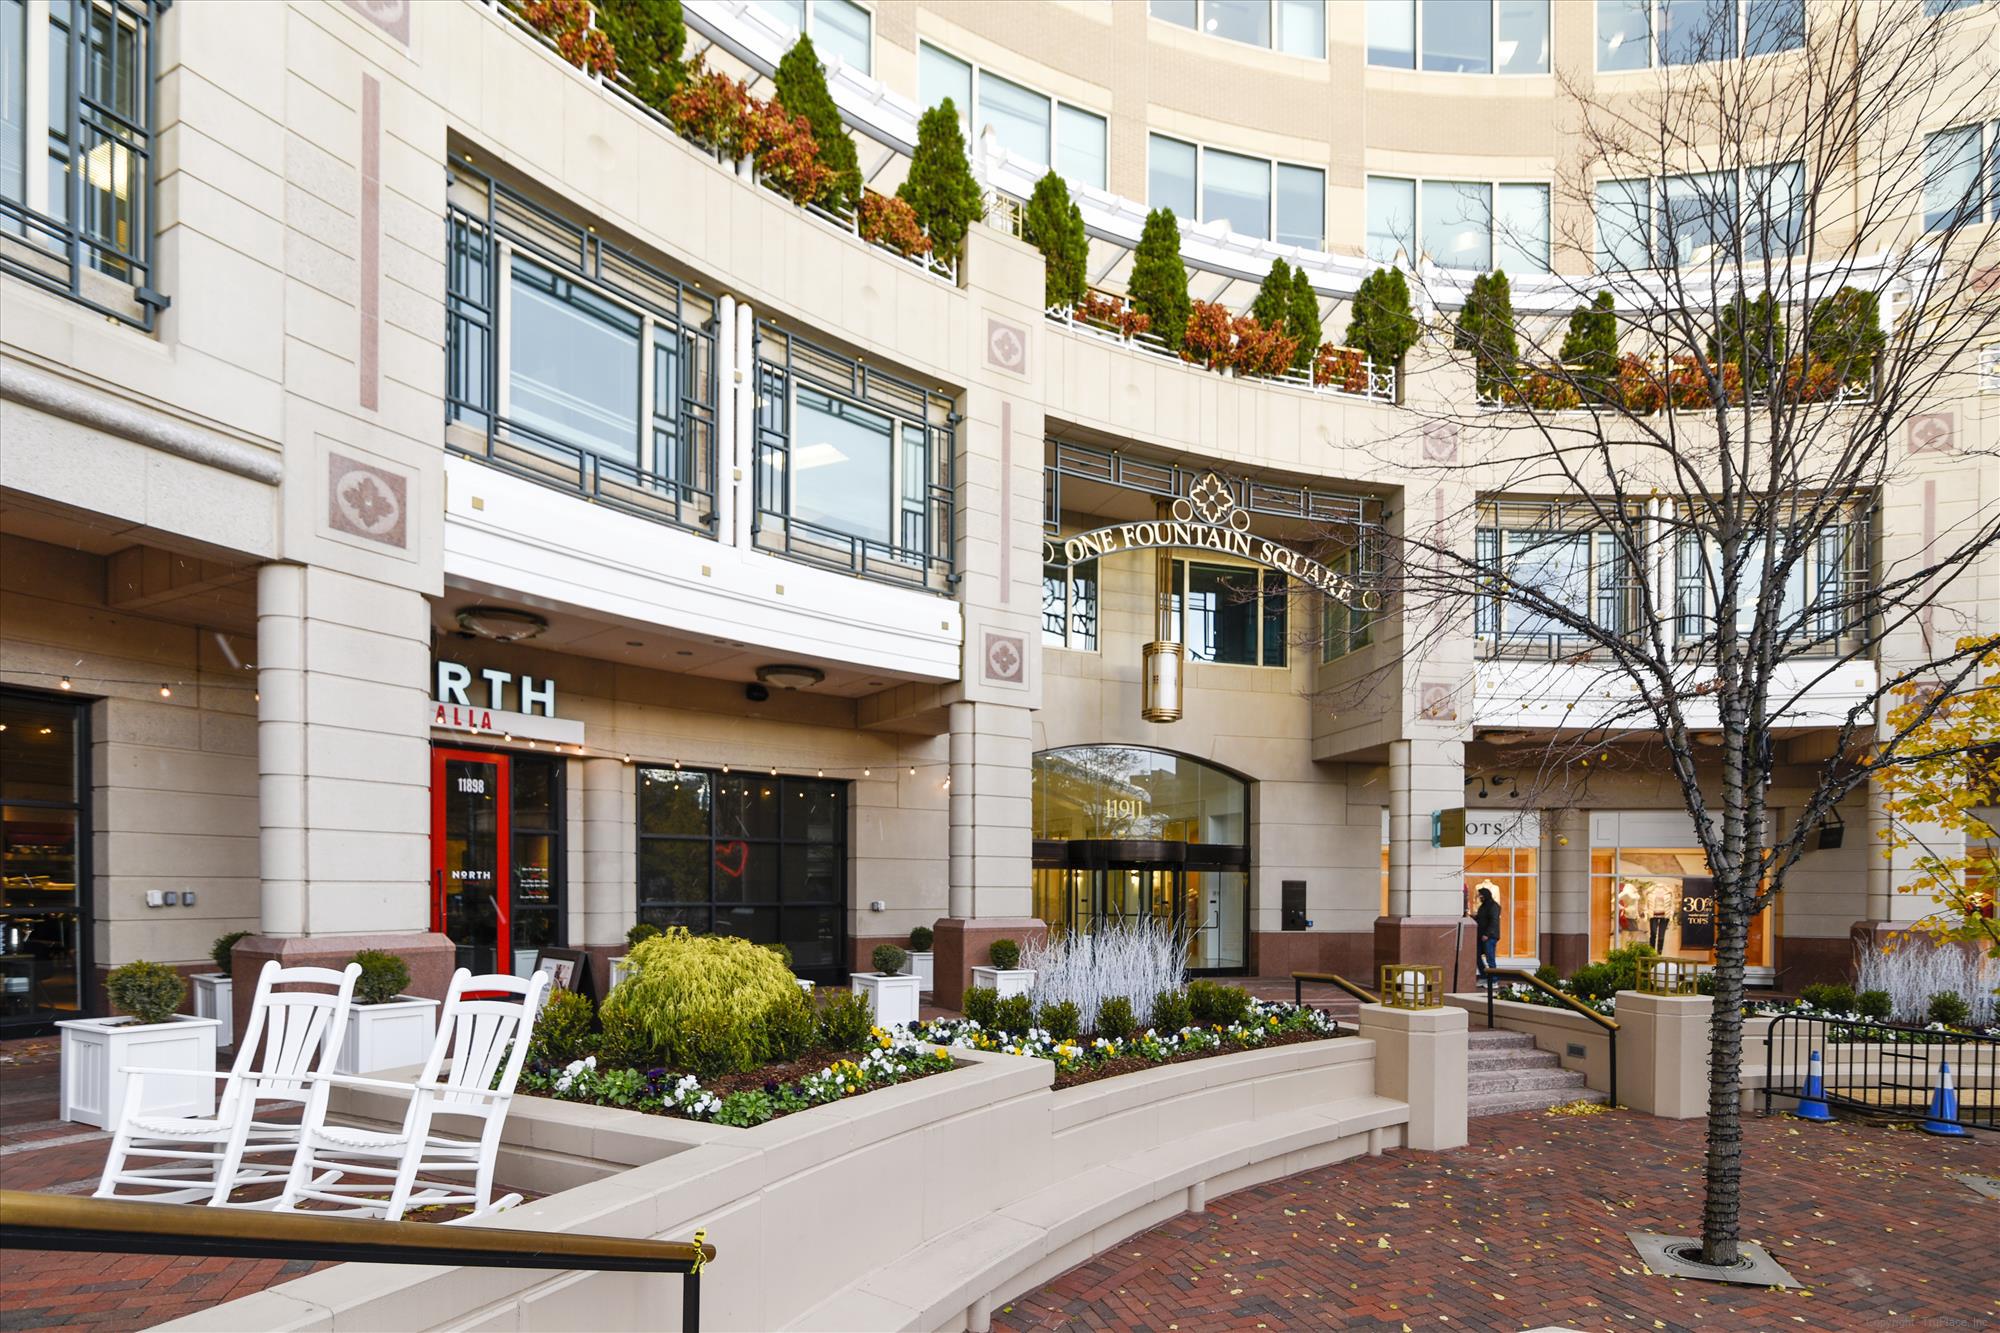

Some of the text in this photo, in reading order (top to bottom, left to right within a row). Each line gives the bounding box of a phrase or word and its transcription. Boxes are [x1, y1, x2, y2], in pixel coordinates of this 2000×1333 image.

[1064, 524, 1355, 602] ONE FOUNTAIN SQUARE
[437, 660, 555, 718] RTH
[457, 777, 485, 794] 11898
[1105, 799, 1143, 818] 11911
[1465, 822, 1503, 836] OTS
[451, 870, 491, 880] NORTH
[1687, 917, 1709, 925] TOPS
